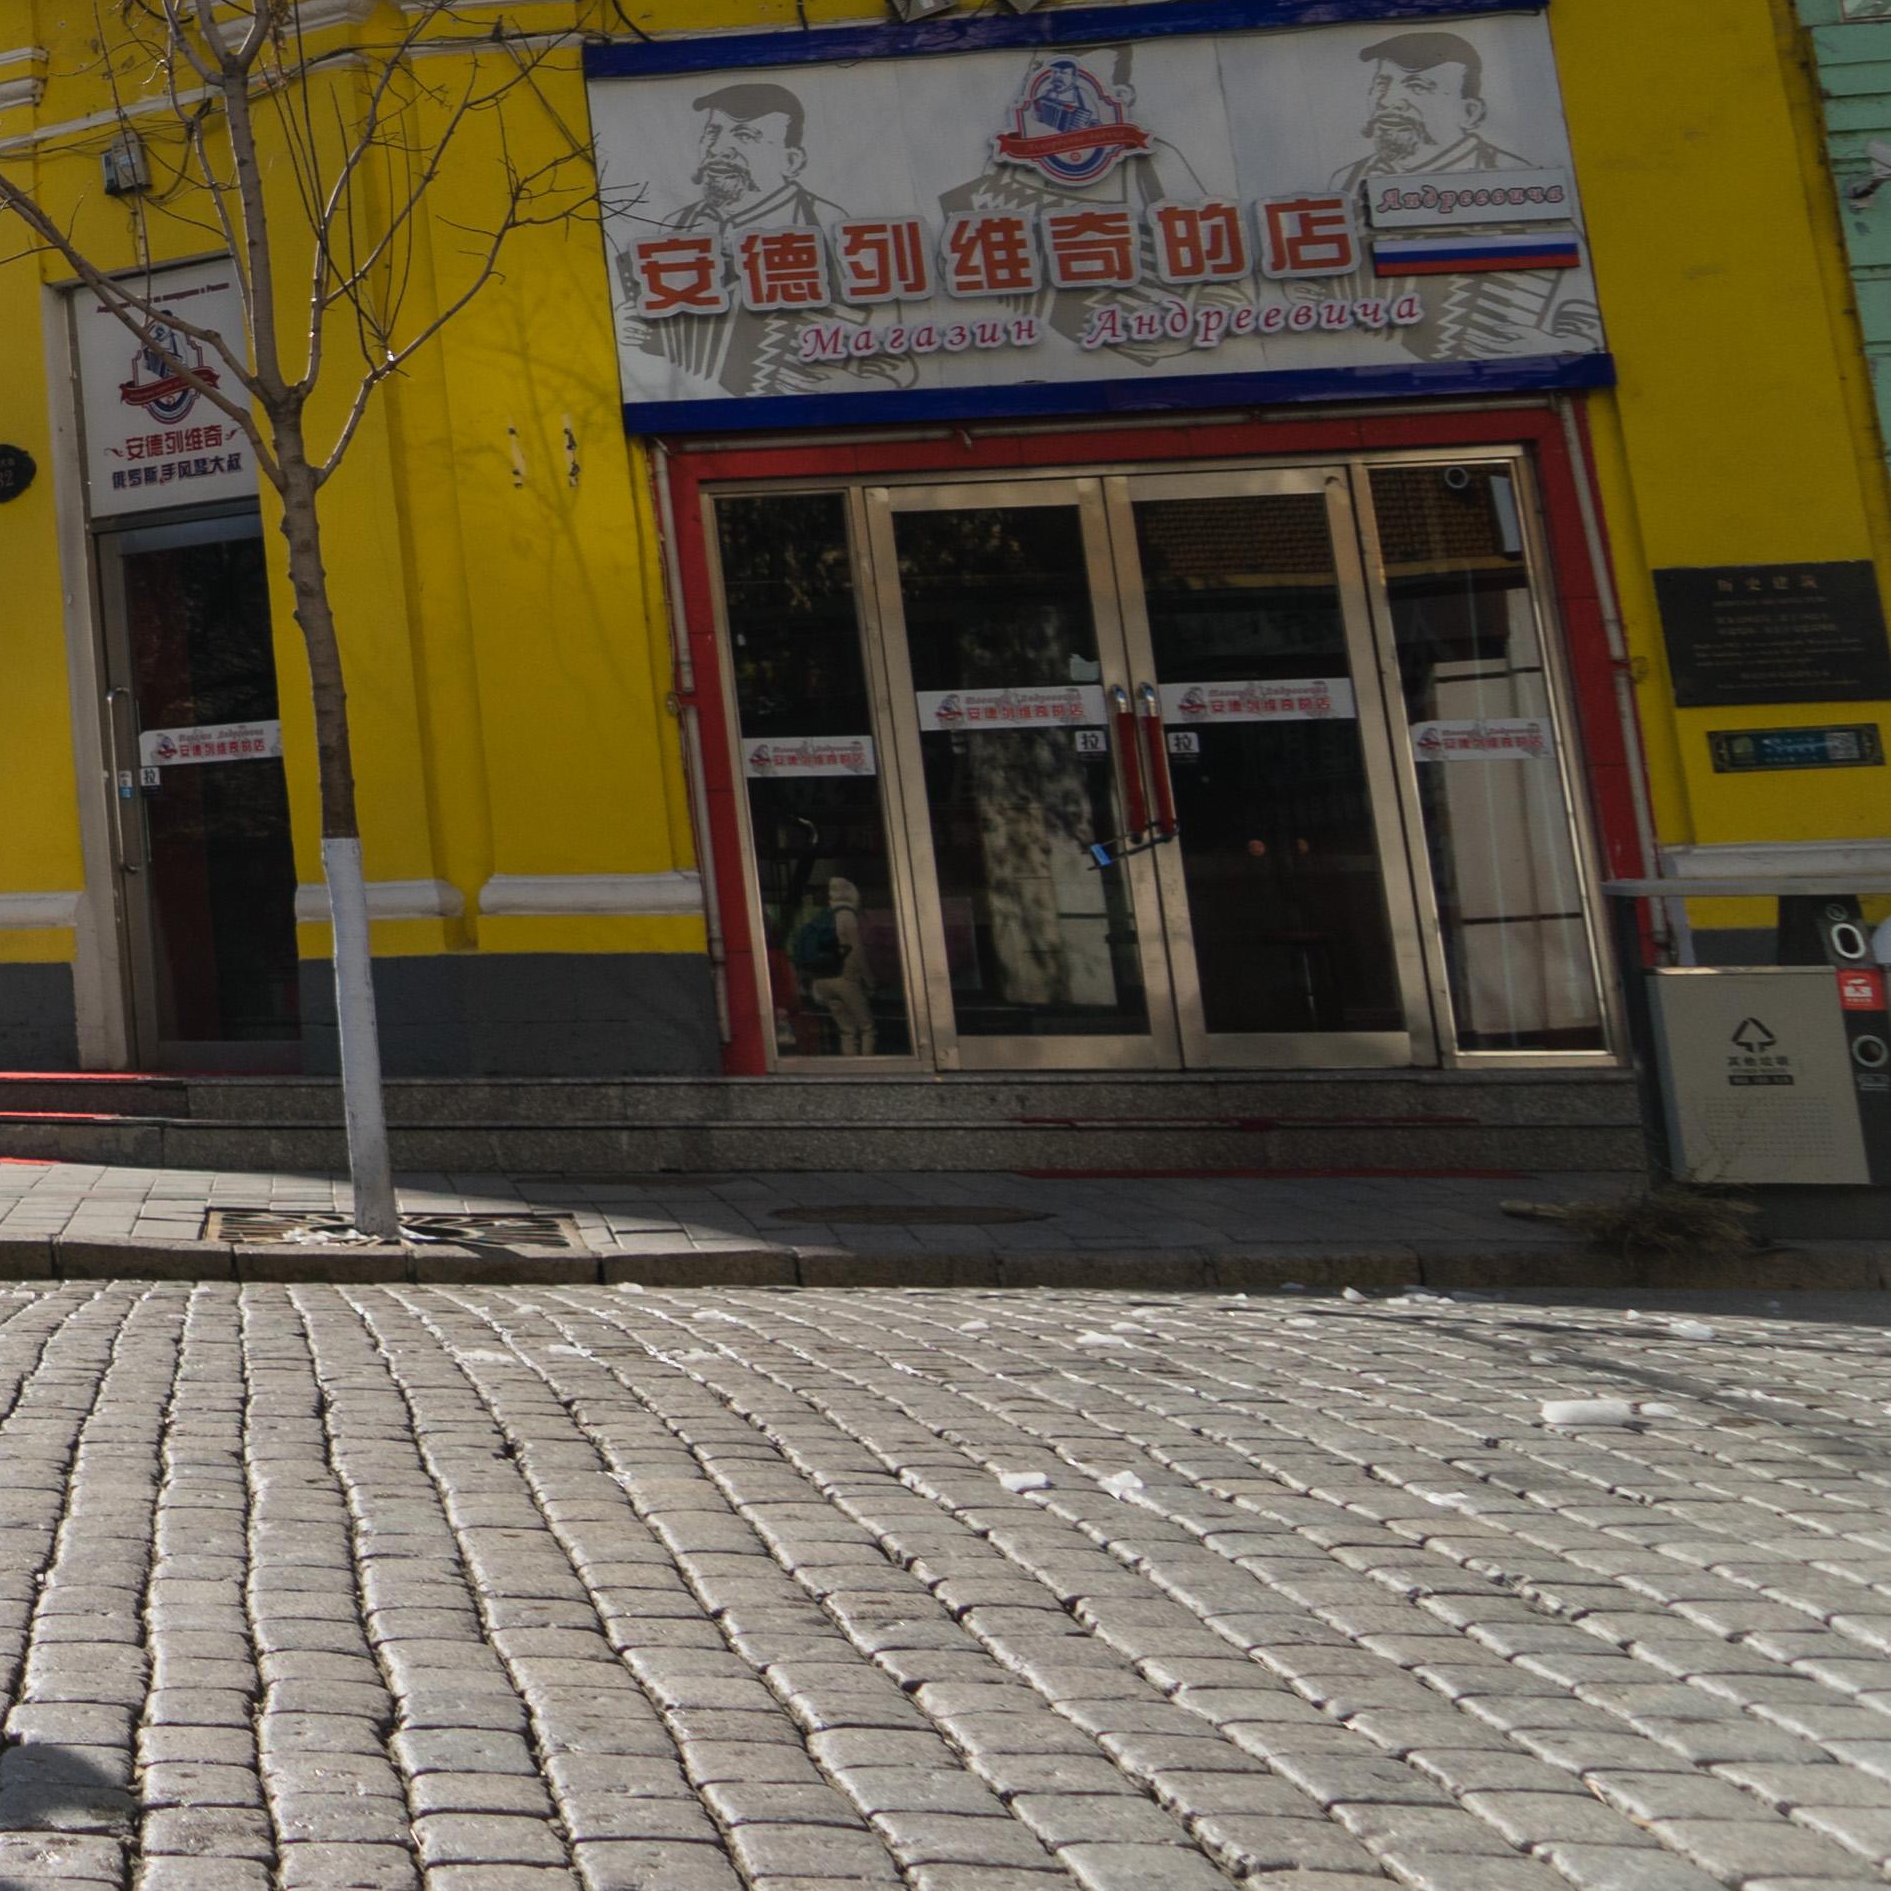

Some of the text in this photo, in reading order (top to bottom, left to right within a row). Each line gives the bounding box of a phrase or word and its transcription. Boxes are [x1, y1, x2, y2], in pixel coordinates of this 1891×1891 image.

[1376, 185, 1564, 214] Андреевича
[637, 198, 1351, 311] 安德列维奇的店
[801, 294, 1422, 361] Магазин Андреевича
[126, 424, 223, 461] 安德列维奇
[1081, 733, 1100, 750] 拉
[1174, 734, 1195, 752] 拉
